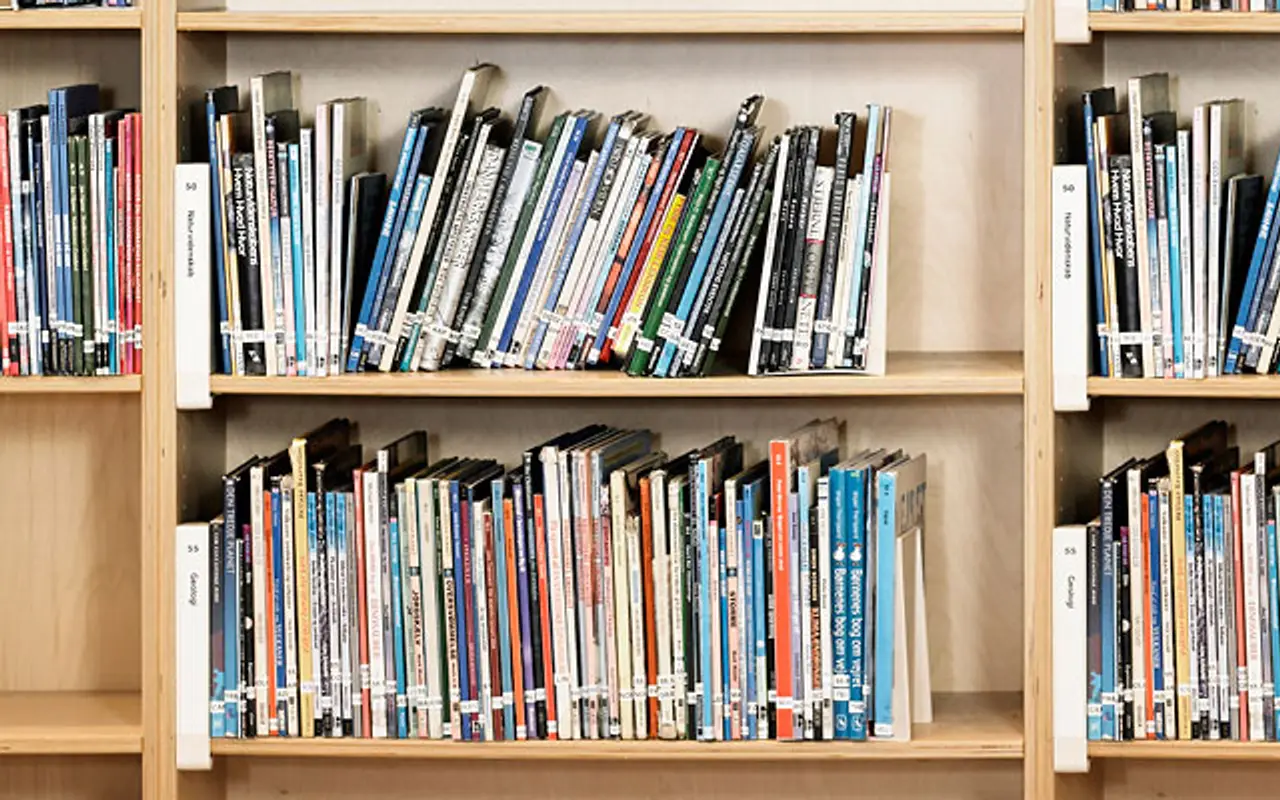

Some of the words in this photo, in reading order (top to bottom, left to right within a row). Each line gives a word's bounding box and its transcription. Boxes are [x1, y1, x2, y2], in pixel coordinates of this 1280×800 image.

[226, 487, 236, 507] DEN
[1103, 489, 1114, 509] DEN
[226, 509, 236, 540] TREDJE
[1103, 511, 1114, 542] TREDJE
[226, 541, 236, 575] PLANET
[1103, 543, 1114, 577] PLANET
[189, 572, 199, 607] Geologi
[833, 568, 848, 615] Børnenes
[849, 569, 863, 616] Børnenes
[1066, 574, 1077, 609] Geologi
[411, 590, 422, 646] JORDSKÆLV
[445, 579, 456, 660] OVERSVØMMELSE
[729, 590, 737, 629] STORME
[832, 616, 848, 636] bog
[849, 617, 863, 640] bog
[834, 638, 846, 657] om
[851, 640, 862, 660] om
[849, 661, 864, 688] vejret
